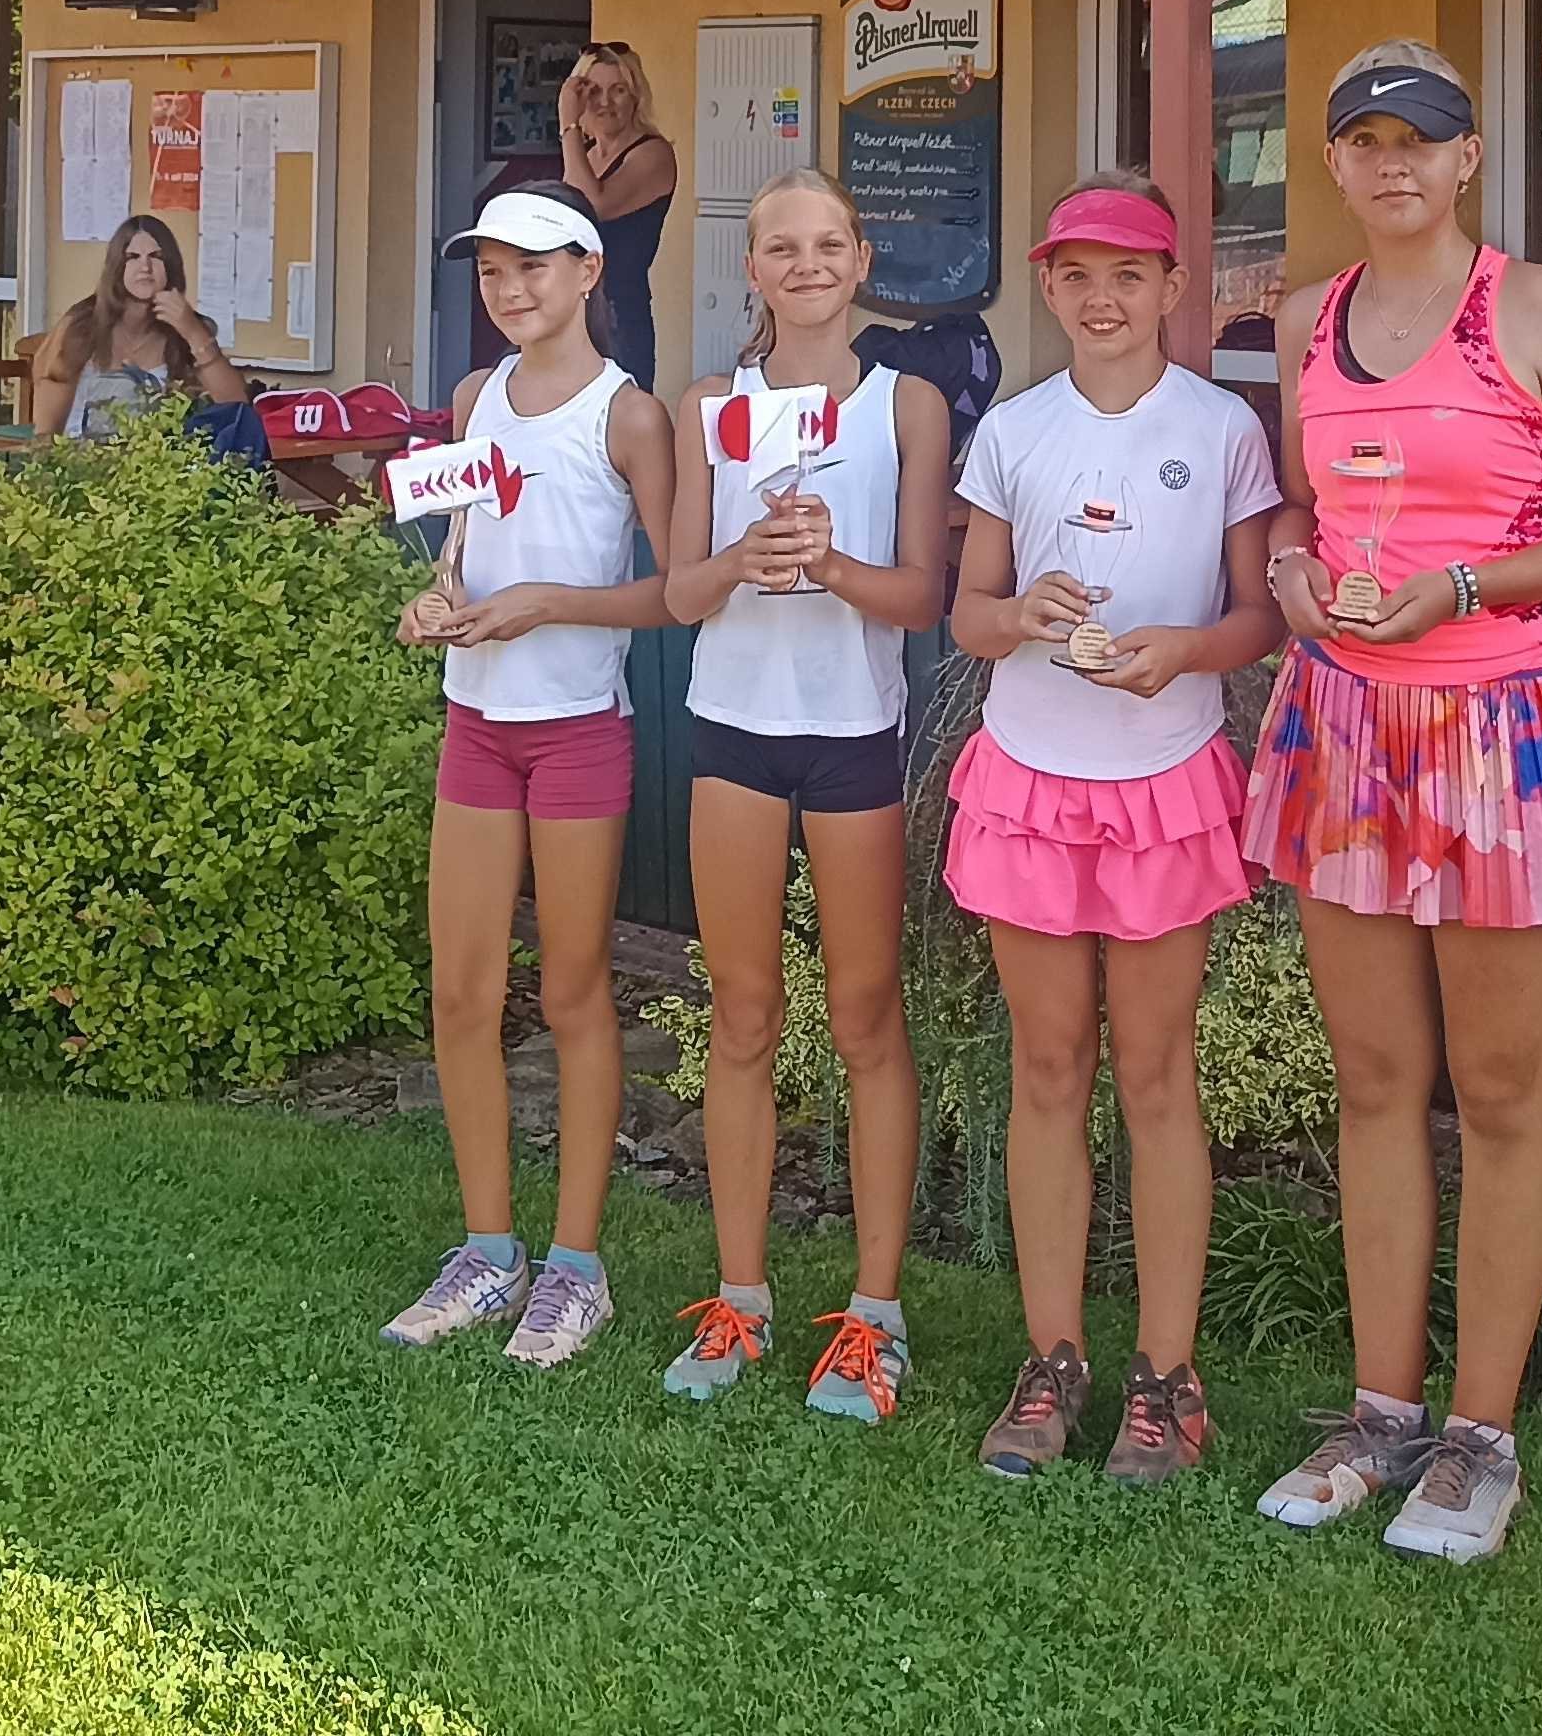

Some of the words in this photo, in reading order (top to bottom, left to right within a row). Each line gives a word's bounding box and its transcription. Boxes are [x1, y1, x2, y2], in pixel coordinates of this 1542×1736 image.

[855, 11, 918, 71] Pilsner
[916, 8, 978, 50] Urquell
[920, 97, 956, 109] CZECH
[294, 404, 324, 433] W
